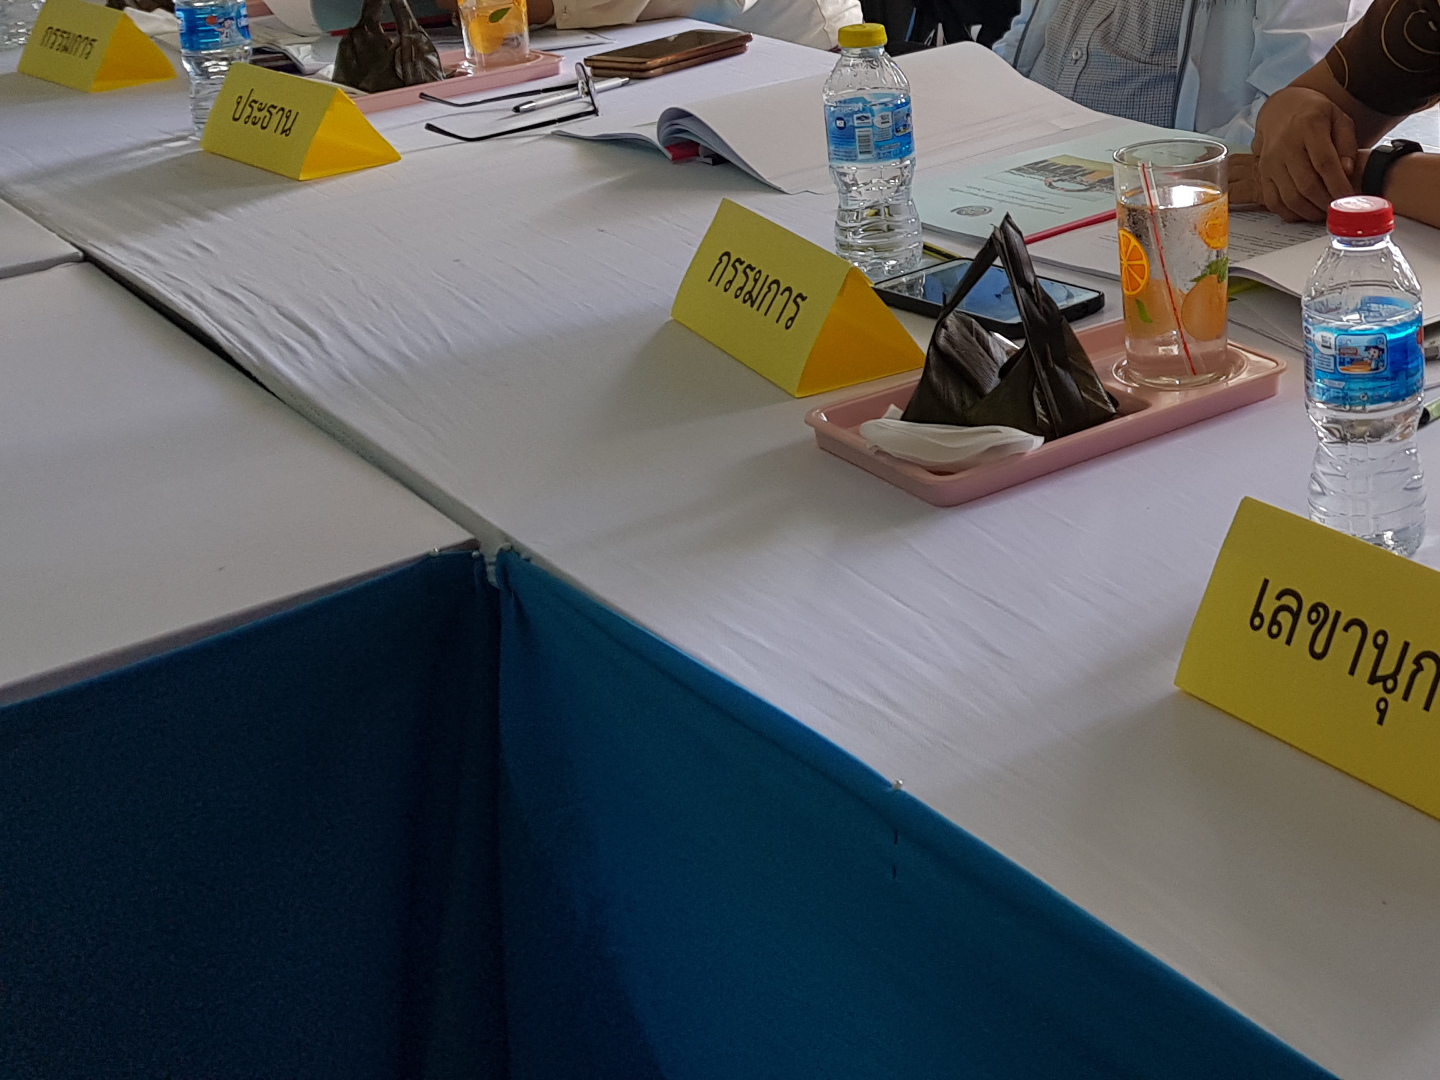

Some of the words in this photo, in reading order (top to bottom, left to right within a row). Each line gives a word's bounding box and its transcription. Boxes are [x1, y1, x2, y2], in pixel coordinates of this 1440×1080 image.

[231, 88, 300, 138] ประธาน
[707, 250, 809, 331] กรรมการ
